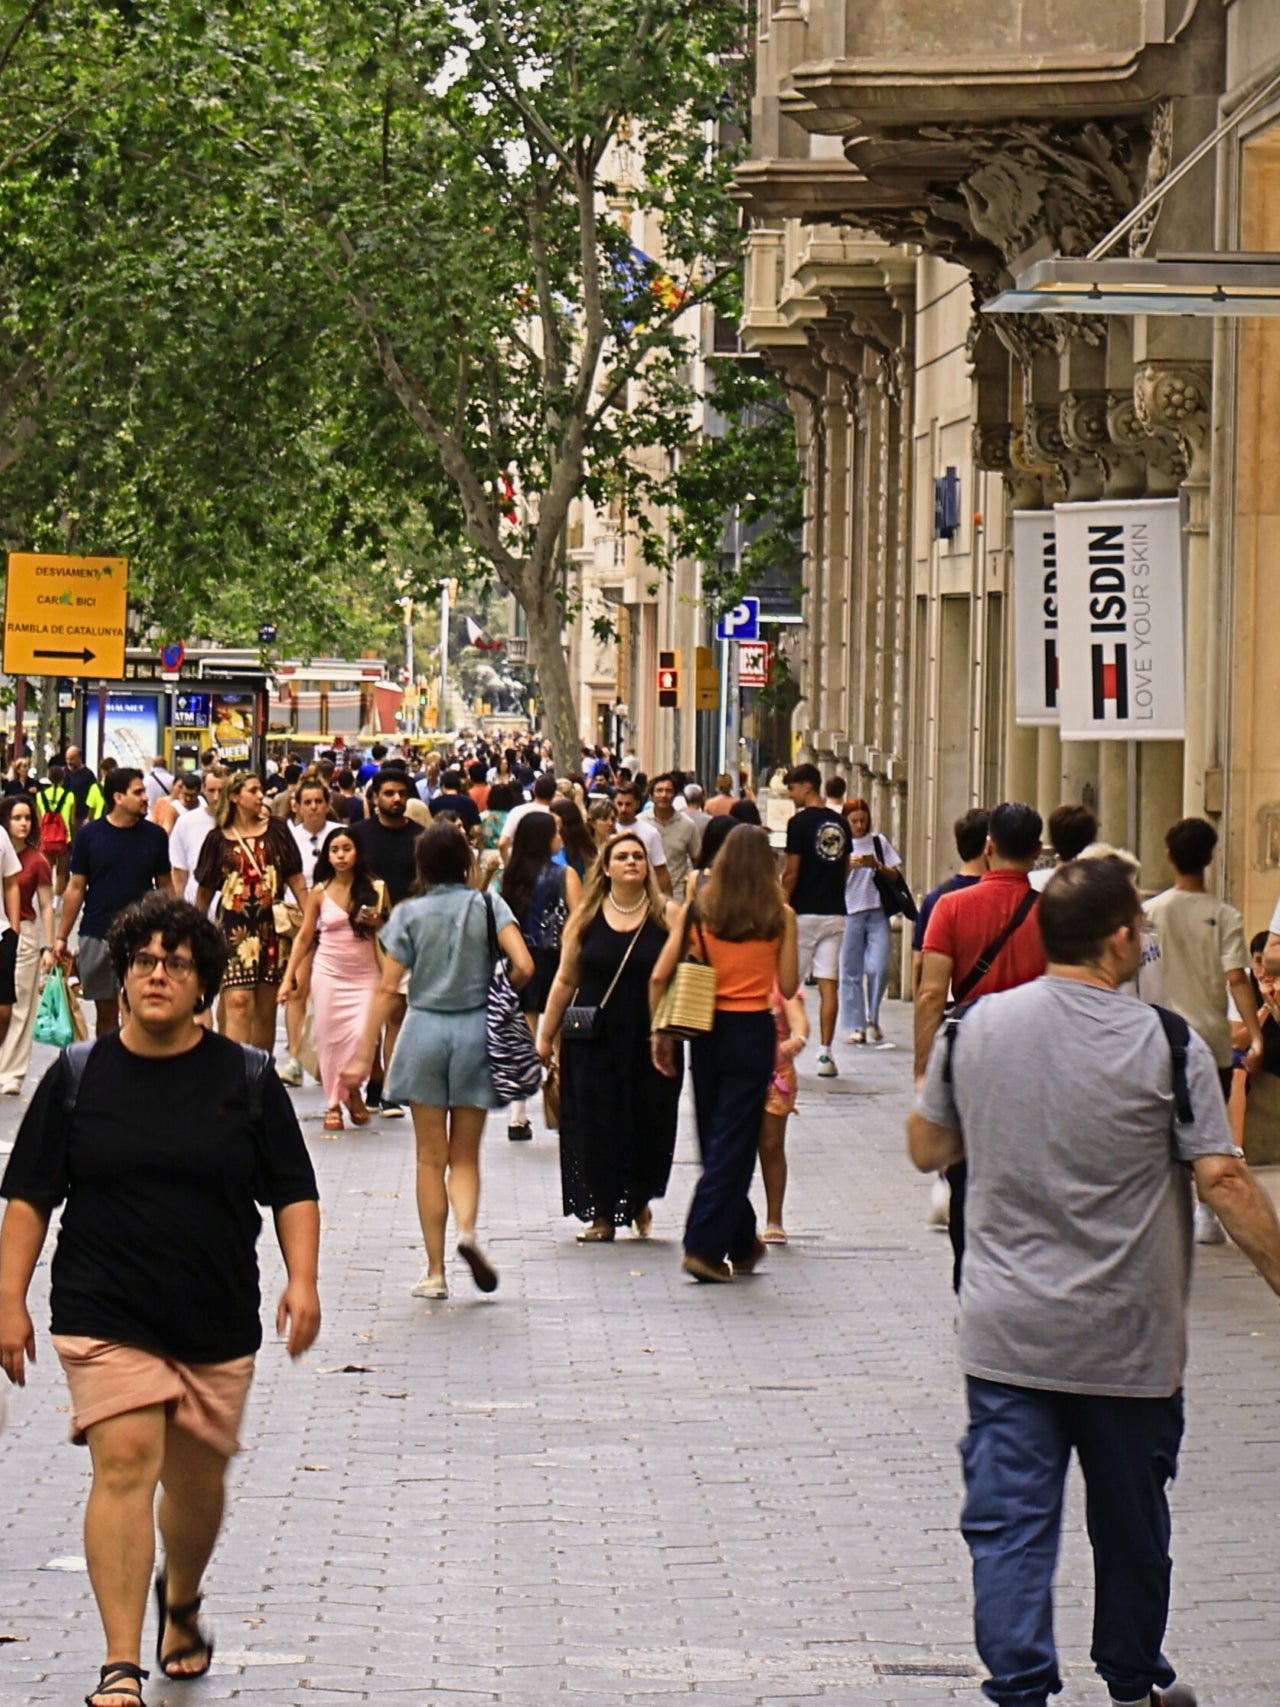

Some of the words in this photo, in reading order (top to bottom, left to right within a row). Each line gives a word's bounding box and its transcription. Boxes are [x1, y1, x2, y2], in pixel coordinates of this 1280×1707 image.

[1131, 523, 1150, 577] SKIN
[36, 567, 98, 578] DESVIAMENT
[1088, 525, 1126, 633] ISDIN
[76, 597, 96, 607] BICI
[725, 604, 750, 635] P
[1132, 584, 1152, 650] YOUR
[8, 623, 48, 633] RAMBLA
[51, 625, 64, 635] DE
[67, 626, 123, 637] CATALUNYA
[1134, 658, 1154, 720] LOVE
